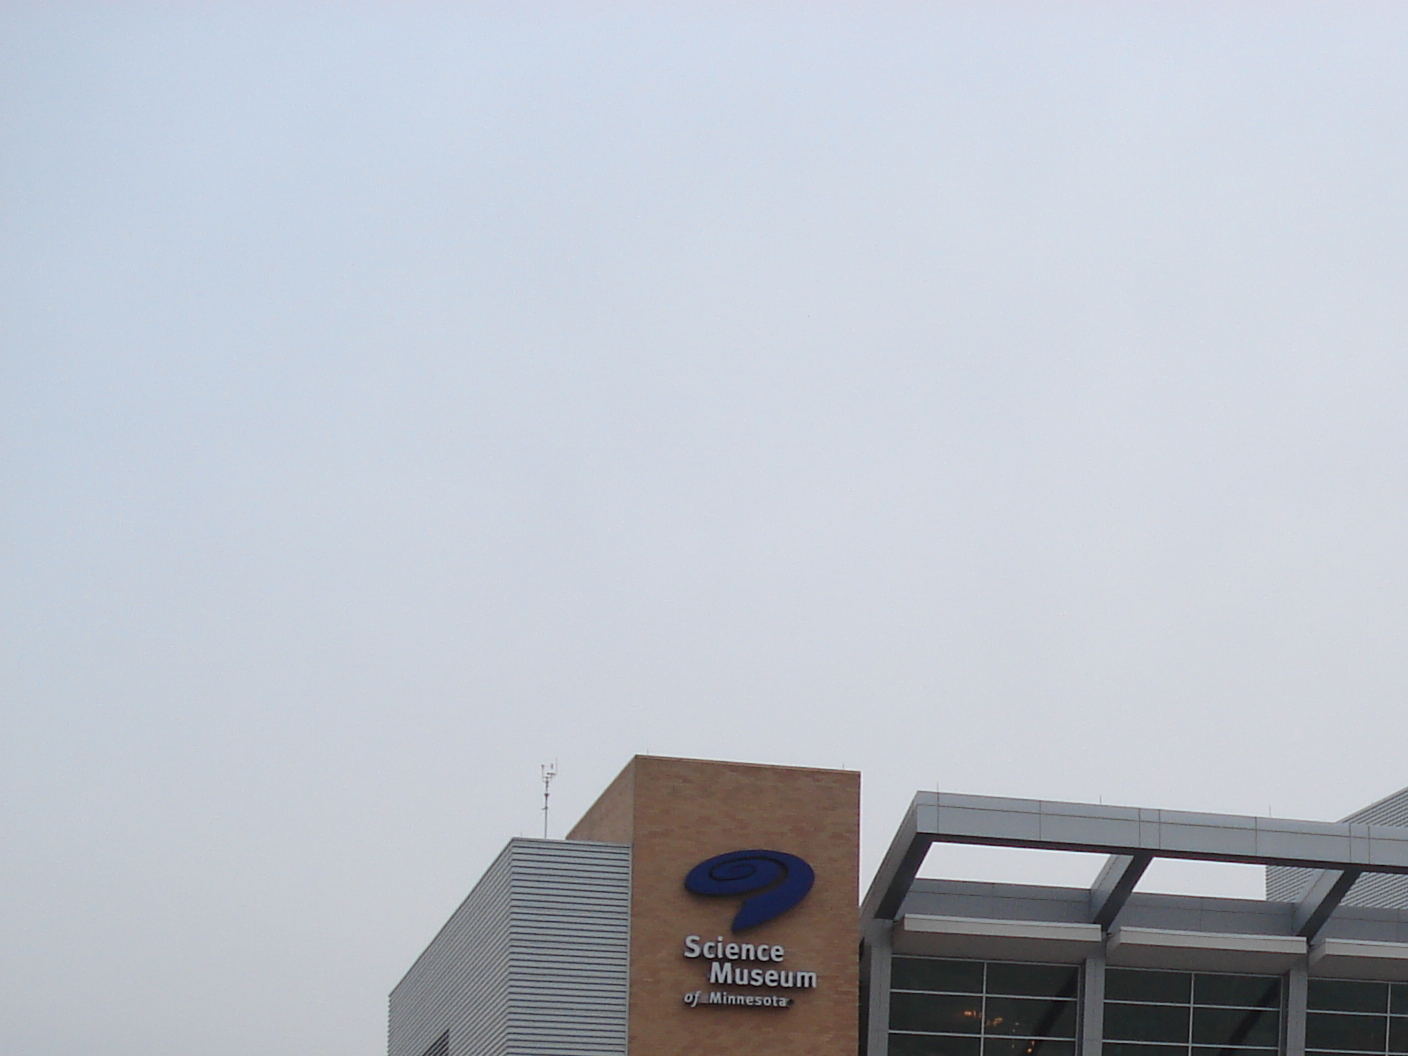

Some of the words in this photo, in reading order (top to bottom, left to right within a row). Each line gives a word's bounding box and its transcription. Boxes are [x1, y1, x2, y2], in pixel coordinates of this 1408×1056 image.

[684, 935, 784, 962] Science
[709, 961, 817, 988] Museum
[684, 991, 702, 1008] of
[710, 991, 788, 1007] Minnesota
